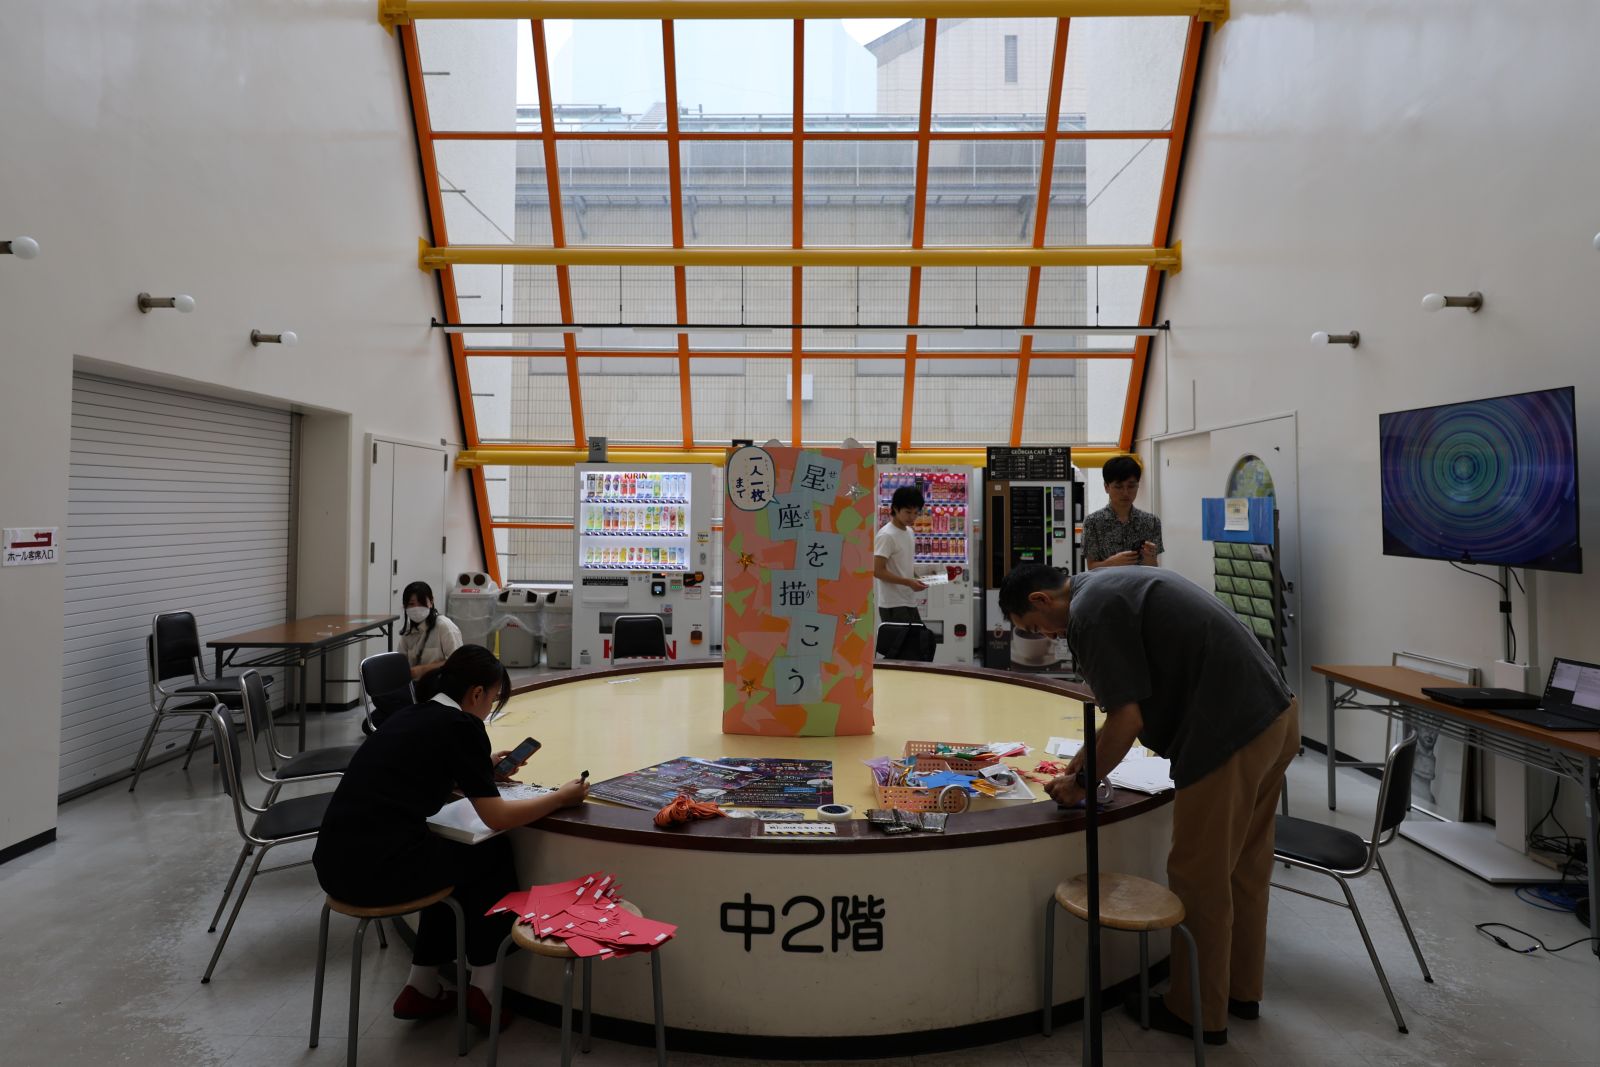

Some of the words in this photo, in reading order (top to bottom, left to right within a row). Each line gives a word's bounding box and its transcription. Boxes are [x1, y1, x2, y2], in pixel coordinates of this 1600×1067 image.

[624, 472, 648, 480] KIRIN
[7, 549, 54, 561] ホール客席入口
[720, 892, 886, 953] 中2階
